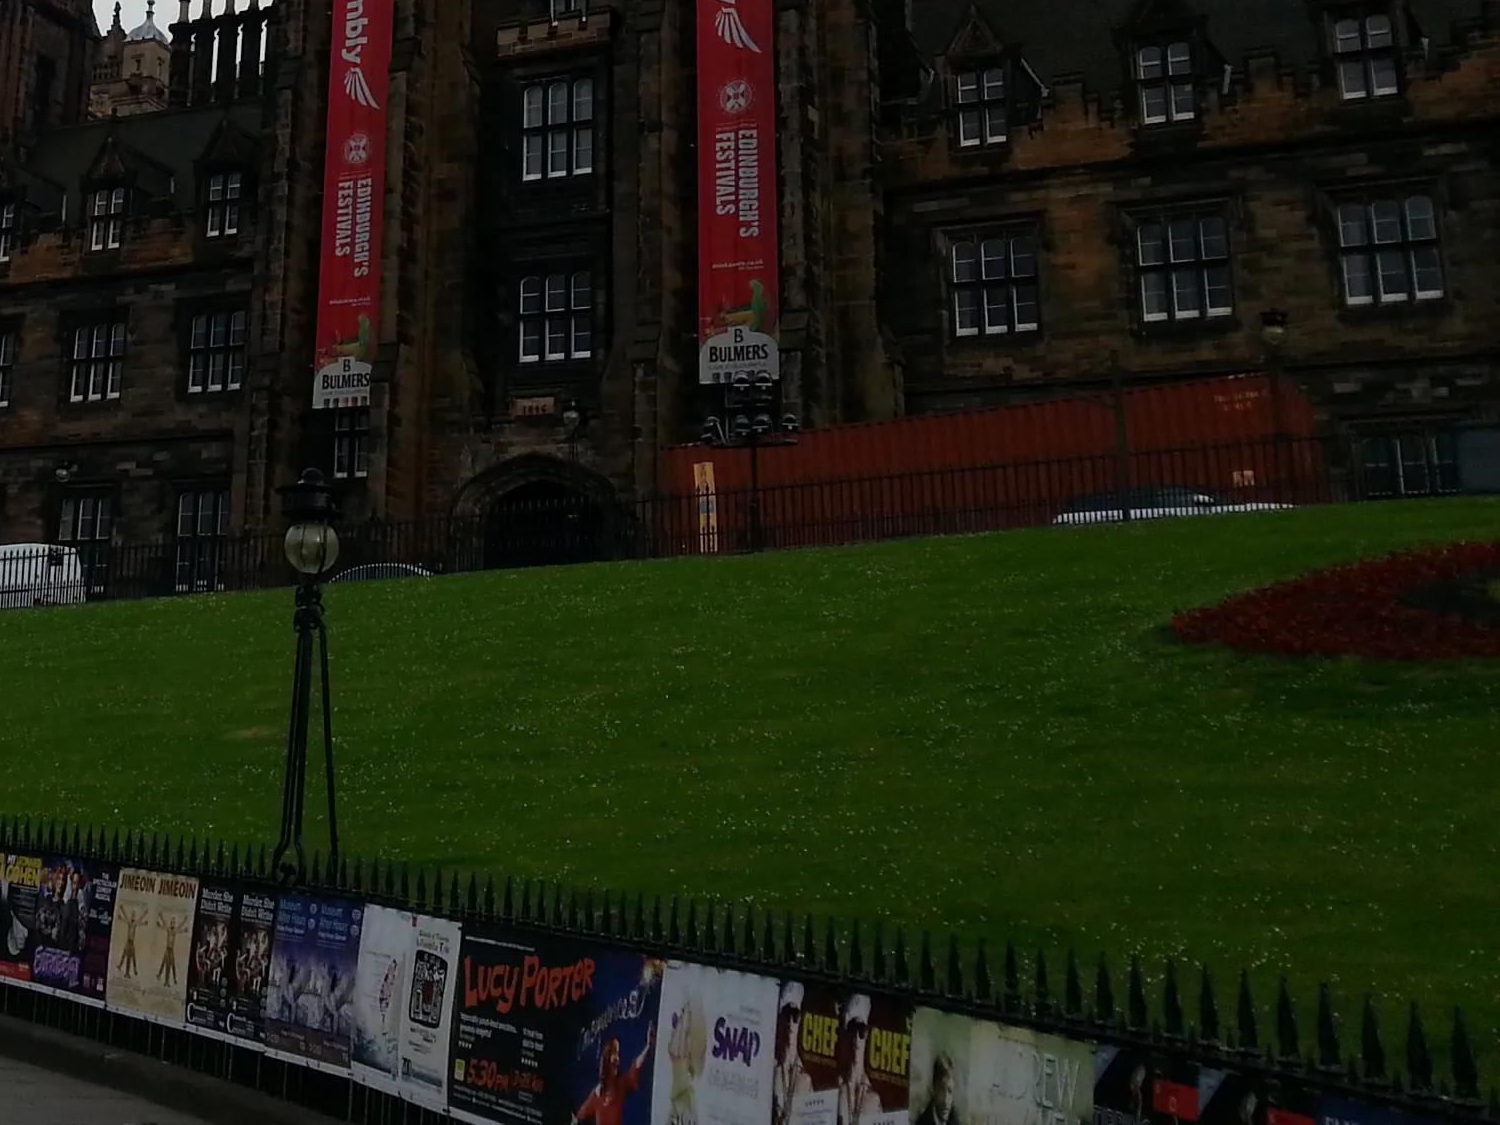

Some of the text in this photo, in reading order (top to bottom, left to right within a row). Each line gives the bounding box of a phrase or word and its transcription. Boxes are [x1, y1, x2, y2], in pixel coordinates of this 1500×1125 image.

[716, 131, 736, 216] FESTIVALS
[738, 129, 759, 238] EDINBURGH'S
[335, 181, 353, 257] FESTIVALS
[354, 178, 373, 278] EDINBURGH'S
[709, 344, 769, 363] BULMERS
[734, 328, 744, 343] B
[322, 373, 372, 390] BULMERS
[343, 359, 351, 372] B
[120, 874, 156, 893] JIMEOIN
[158, 878, 197, 899] JIMEOIN
[712, 1016, 760, 1067] SNAP
[802, 1011, 840, 1058] CHEF
[869, 1027, 910, 1075] CHEF
